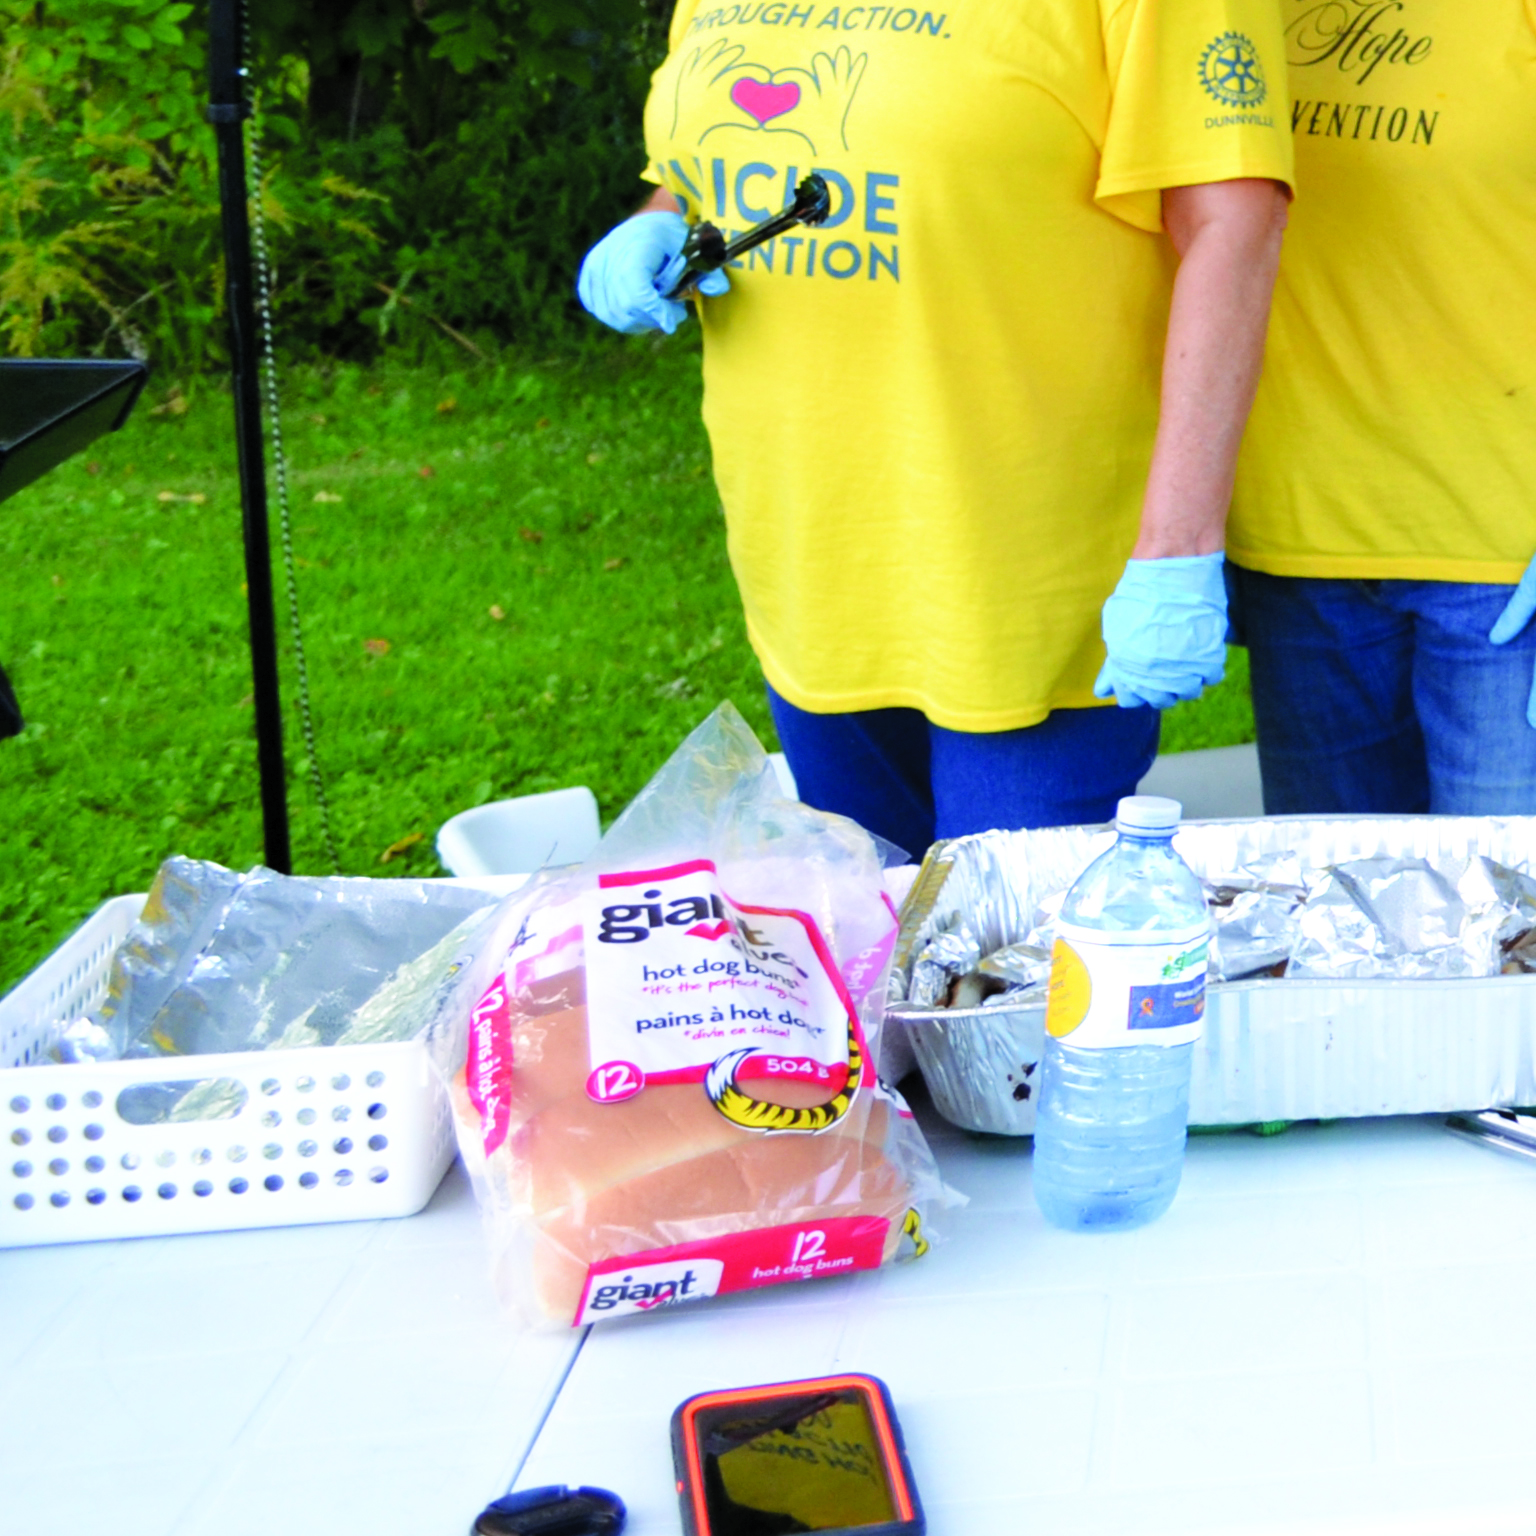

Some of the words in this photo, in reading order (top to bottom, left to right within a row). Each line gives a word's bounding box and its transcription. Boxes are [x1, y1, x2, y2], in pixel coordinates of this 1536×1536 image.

[816, 6, 951, 39] ACTION.
[1291, 100, 1439, 145] VENTION
[643, 964, 687, 981] hot
[693, 958, 741, 976] dog
[708, 976, 760, 993] perfect
[636, 1011, 704, 1034] pains
[710, 1005, 724, 1022] à
[730, 1003, 774, 1022] hot
[596, 1065, 638, 1099] 12
[767, 1058, 814, 1075] 504
[792, 1230, 826, 1262] 12
[752, 1265, 782, 1279] hot
[783, 1260, 813, 1276] dog
[815, 1255, 854, 1271] buns
[589, 1270, 697, 1310] giant
